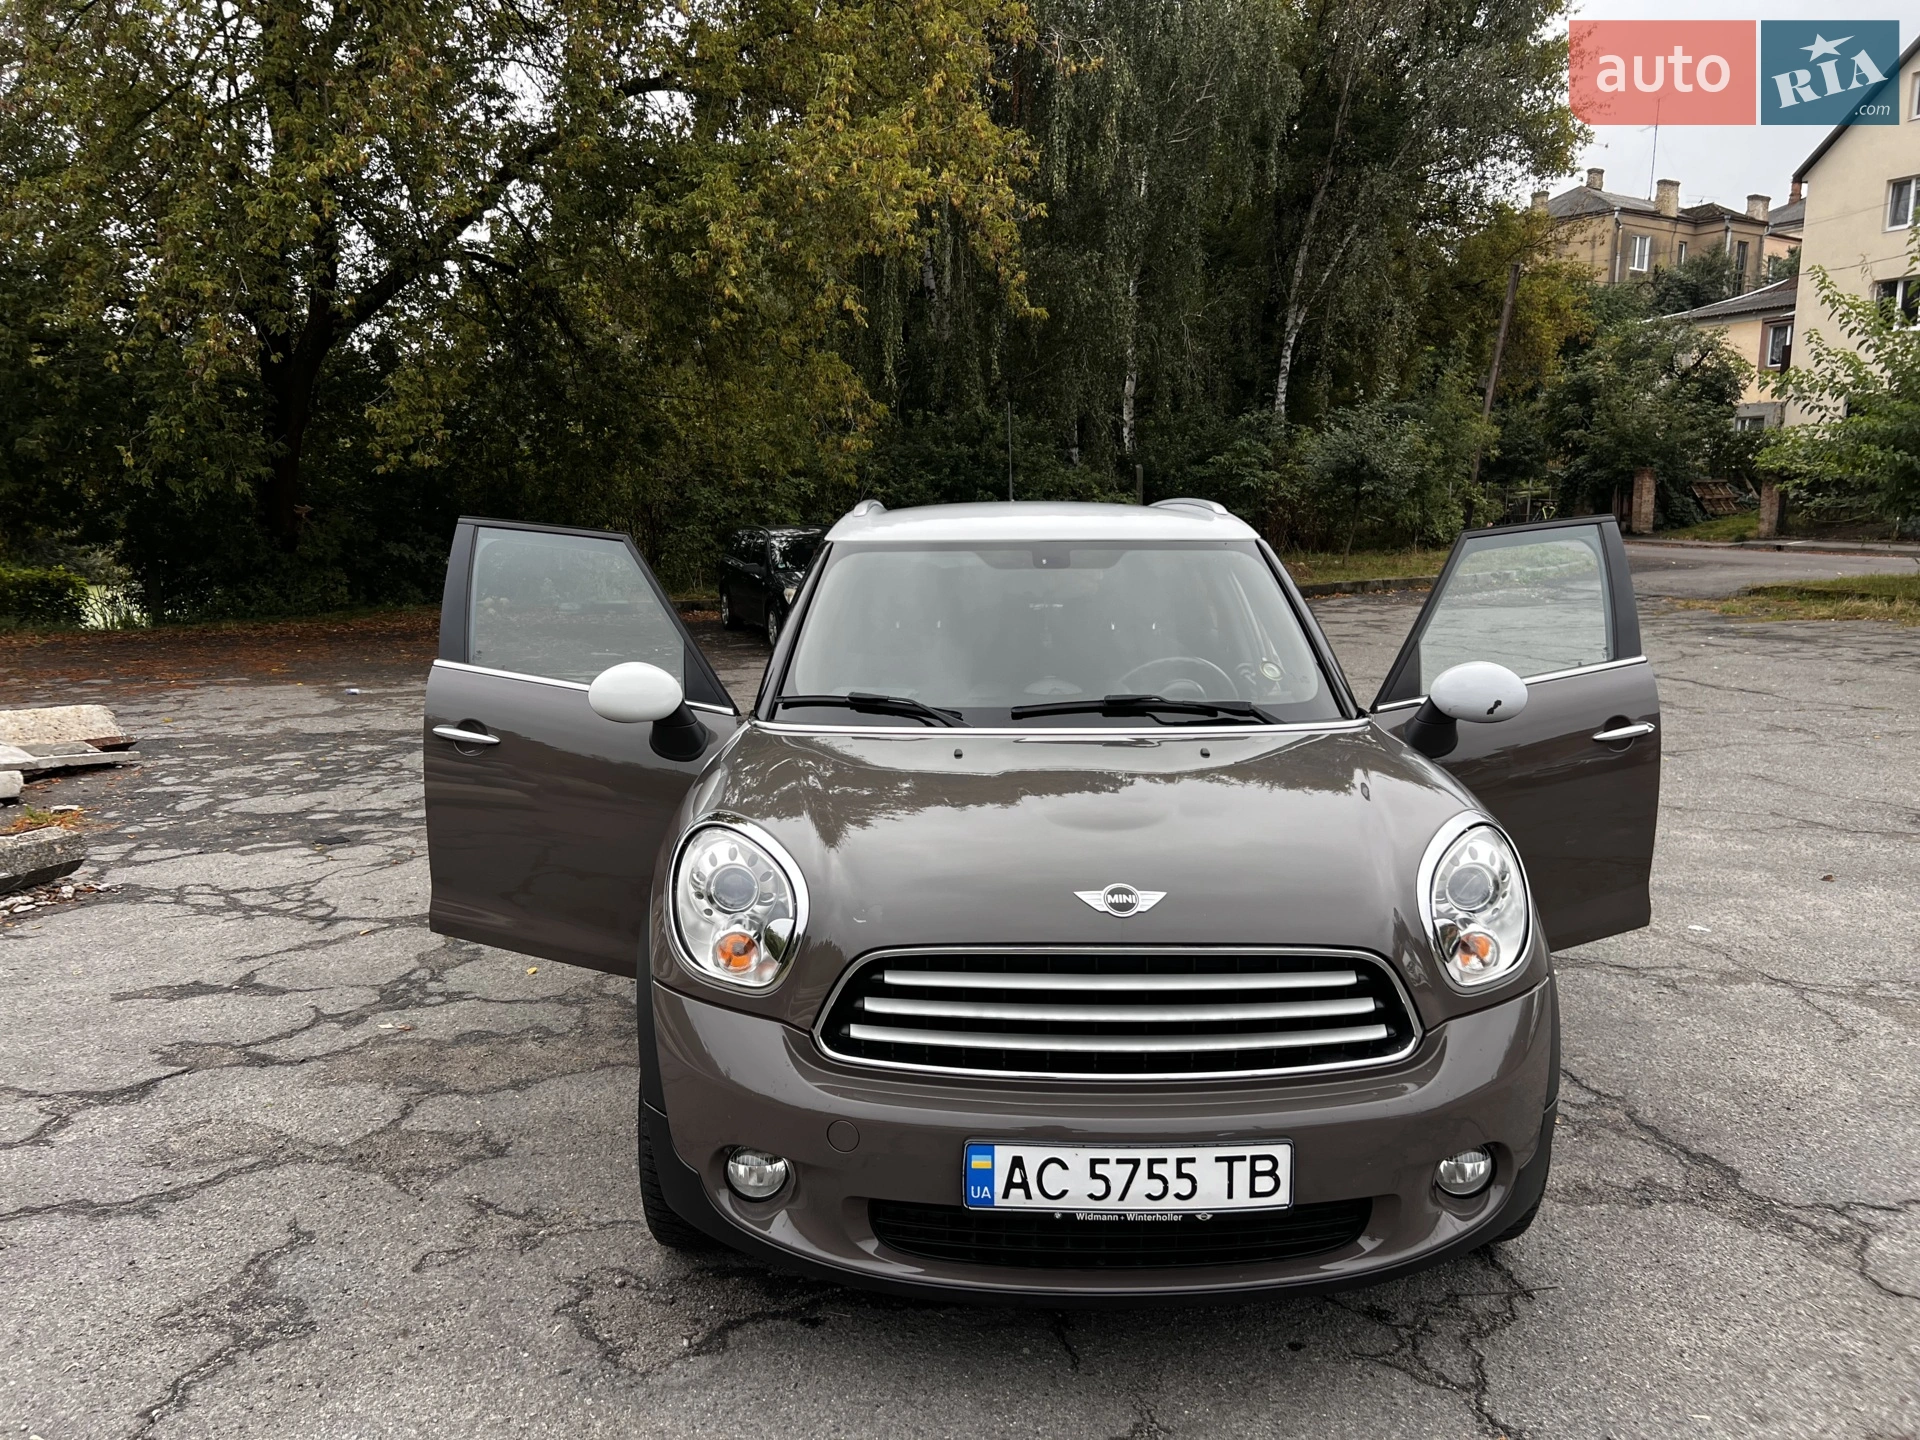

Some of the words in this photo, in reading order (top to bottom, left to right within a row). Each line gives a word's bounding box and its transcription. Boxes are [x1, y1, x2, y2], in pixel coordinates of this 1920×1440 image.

[1107, 893, 1136, 904] MINI
[1002, 1155, 1069, 1201] AC
[1086, 1157, 1197, 1202] 5755
[1214, 1154, 1281, 1200] TB
[970, 1186, 992, 1199] UA
[1076, 1212, 1119, 1221] Widmann
[1126, 1213, 1183, 1222] Winterholler
